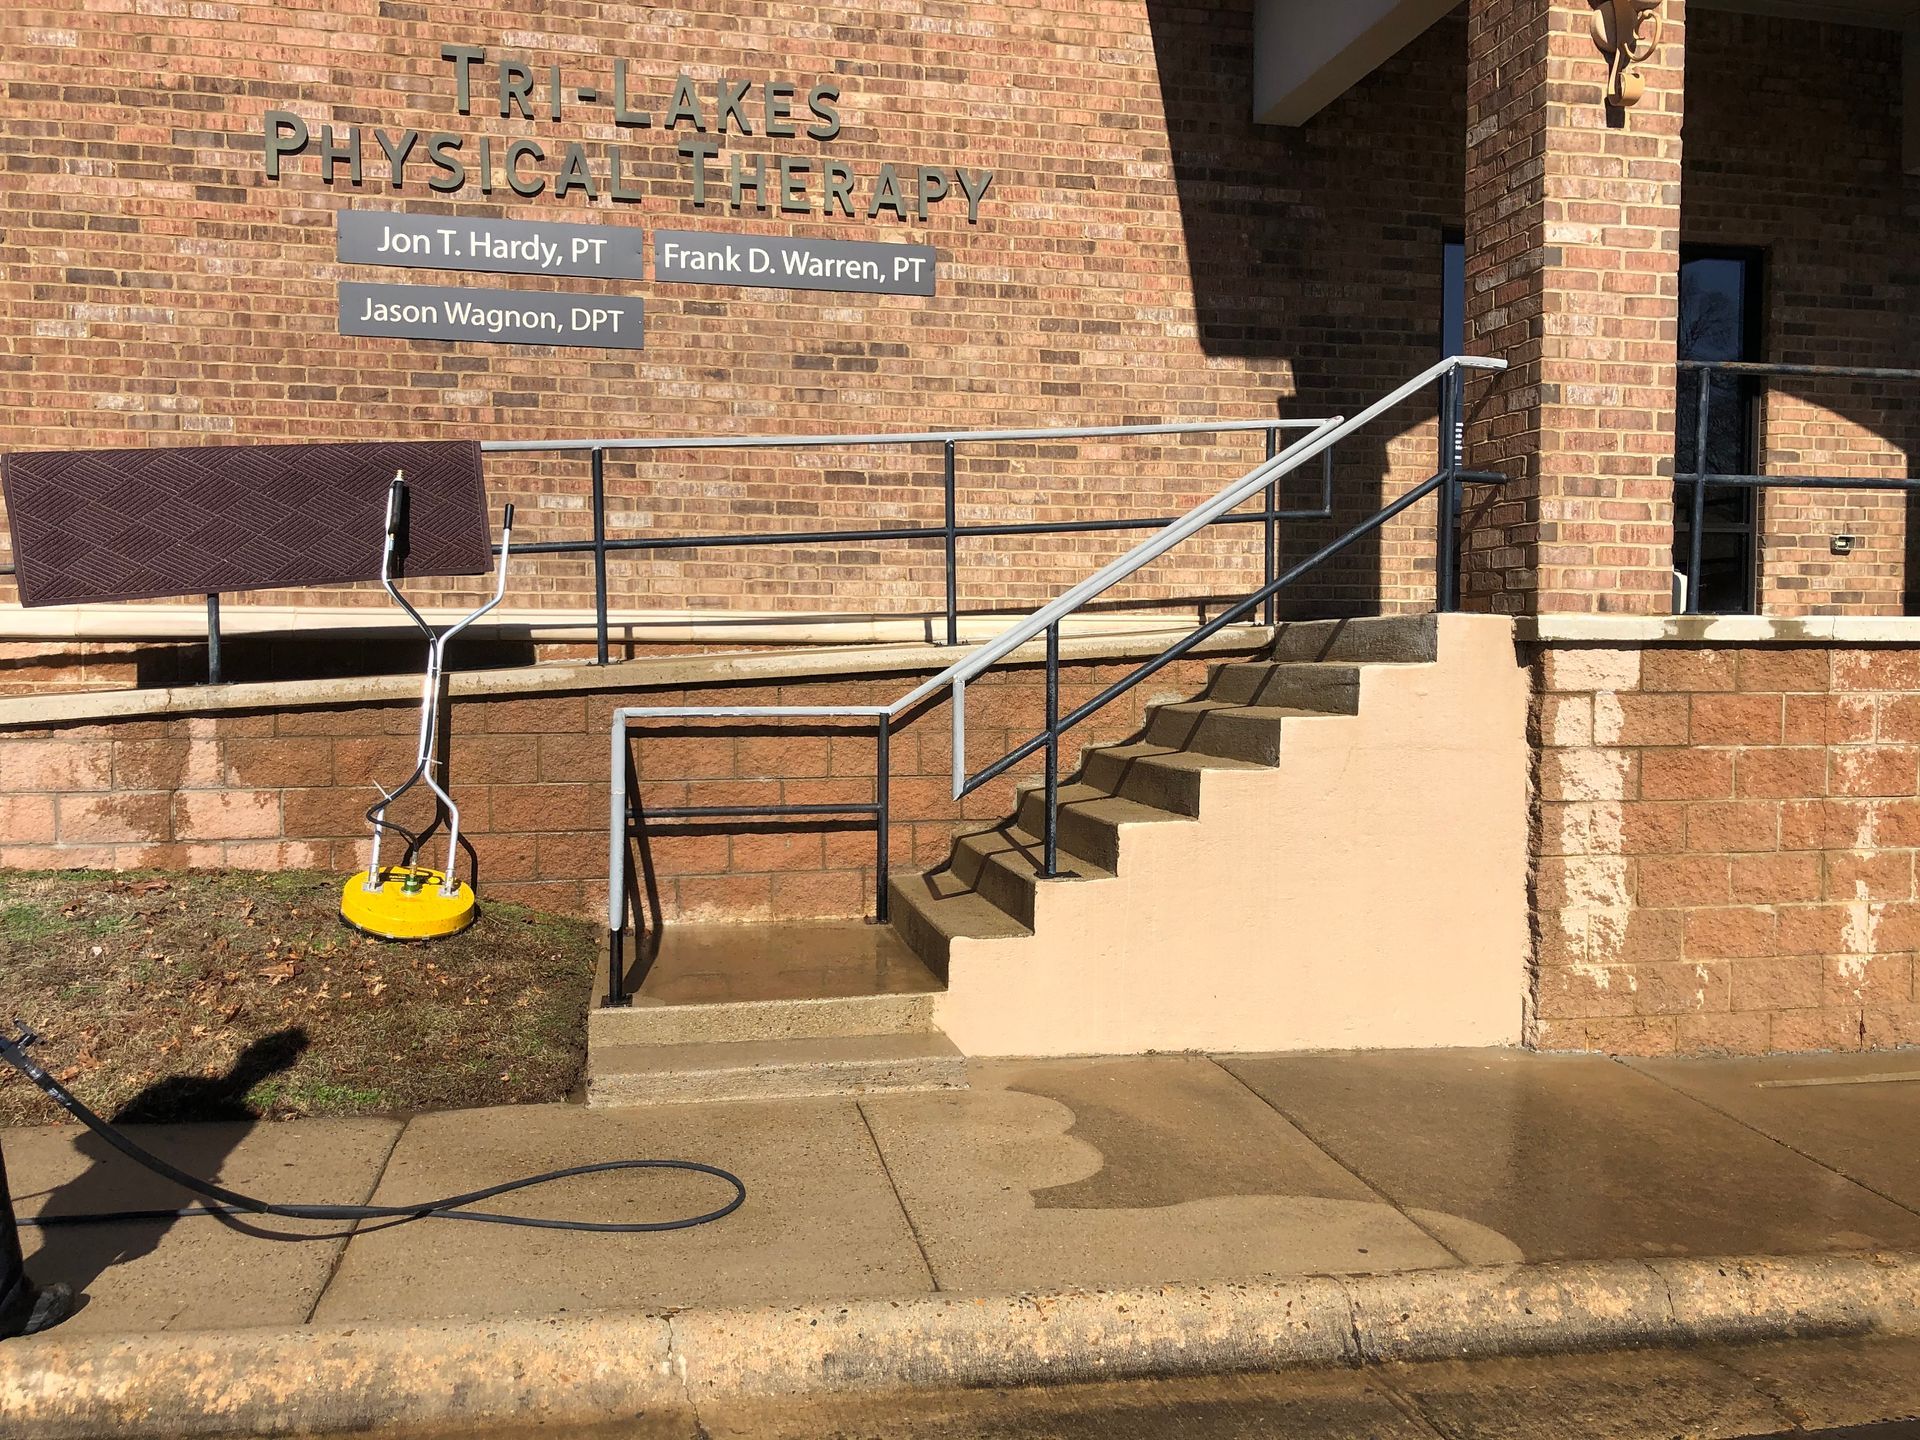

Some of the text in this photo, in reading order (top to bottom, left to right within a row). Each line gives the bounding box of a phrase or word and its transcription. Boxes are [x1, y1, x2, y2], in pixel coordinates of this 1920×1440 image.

[441, 44, 841, 142] TRI-LAKES
[263, 109, 994, 225] PHYSICAL THERAPY
[377, 226, 607, 269] Jon T. Hardy, PT
[663, 243, 926, 284] Frank D. Warren, PT
[360, 298, 625, 334] Jason Wagnon, DPT
